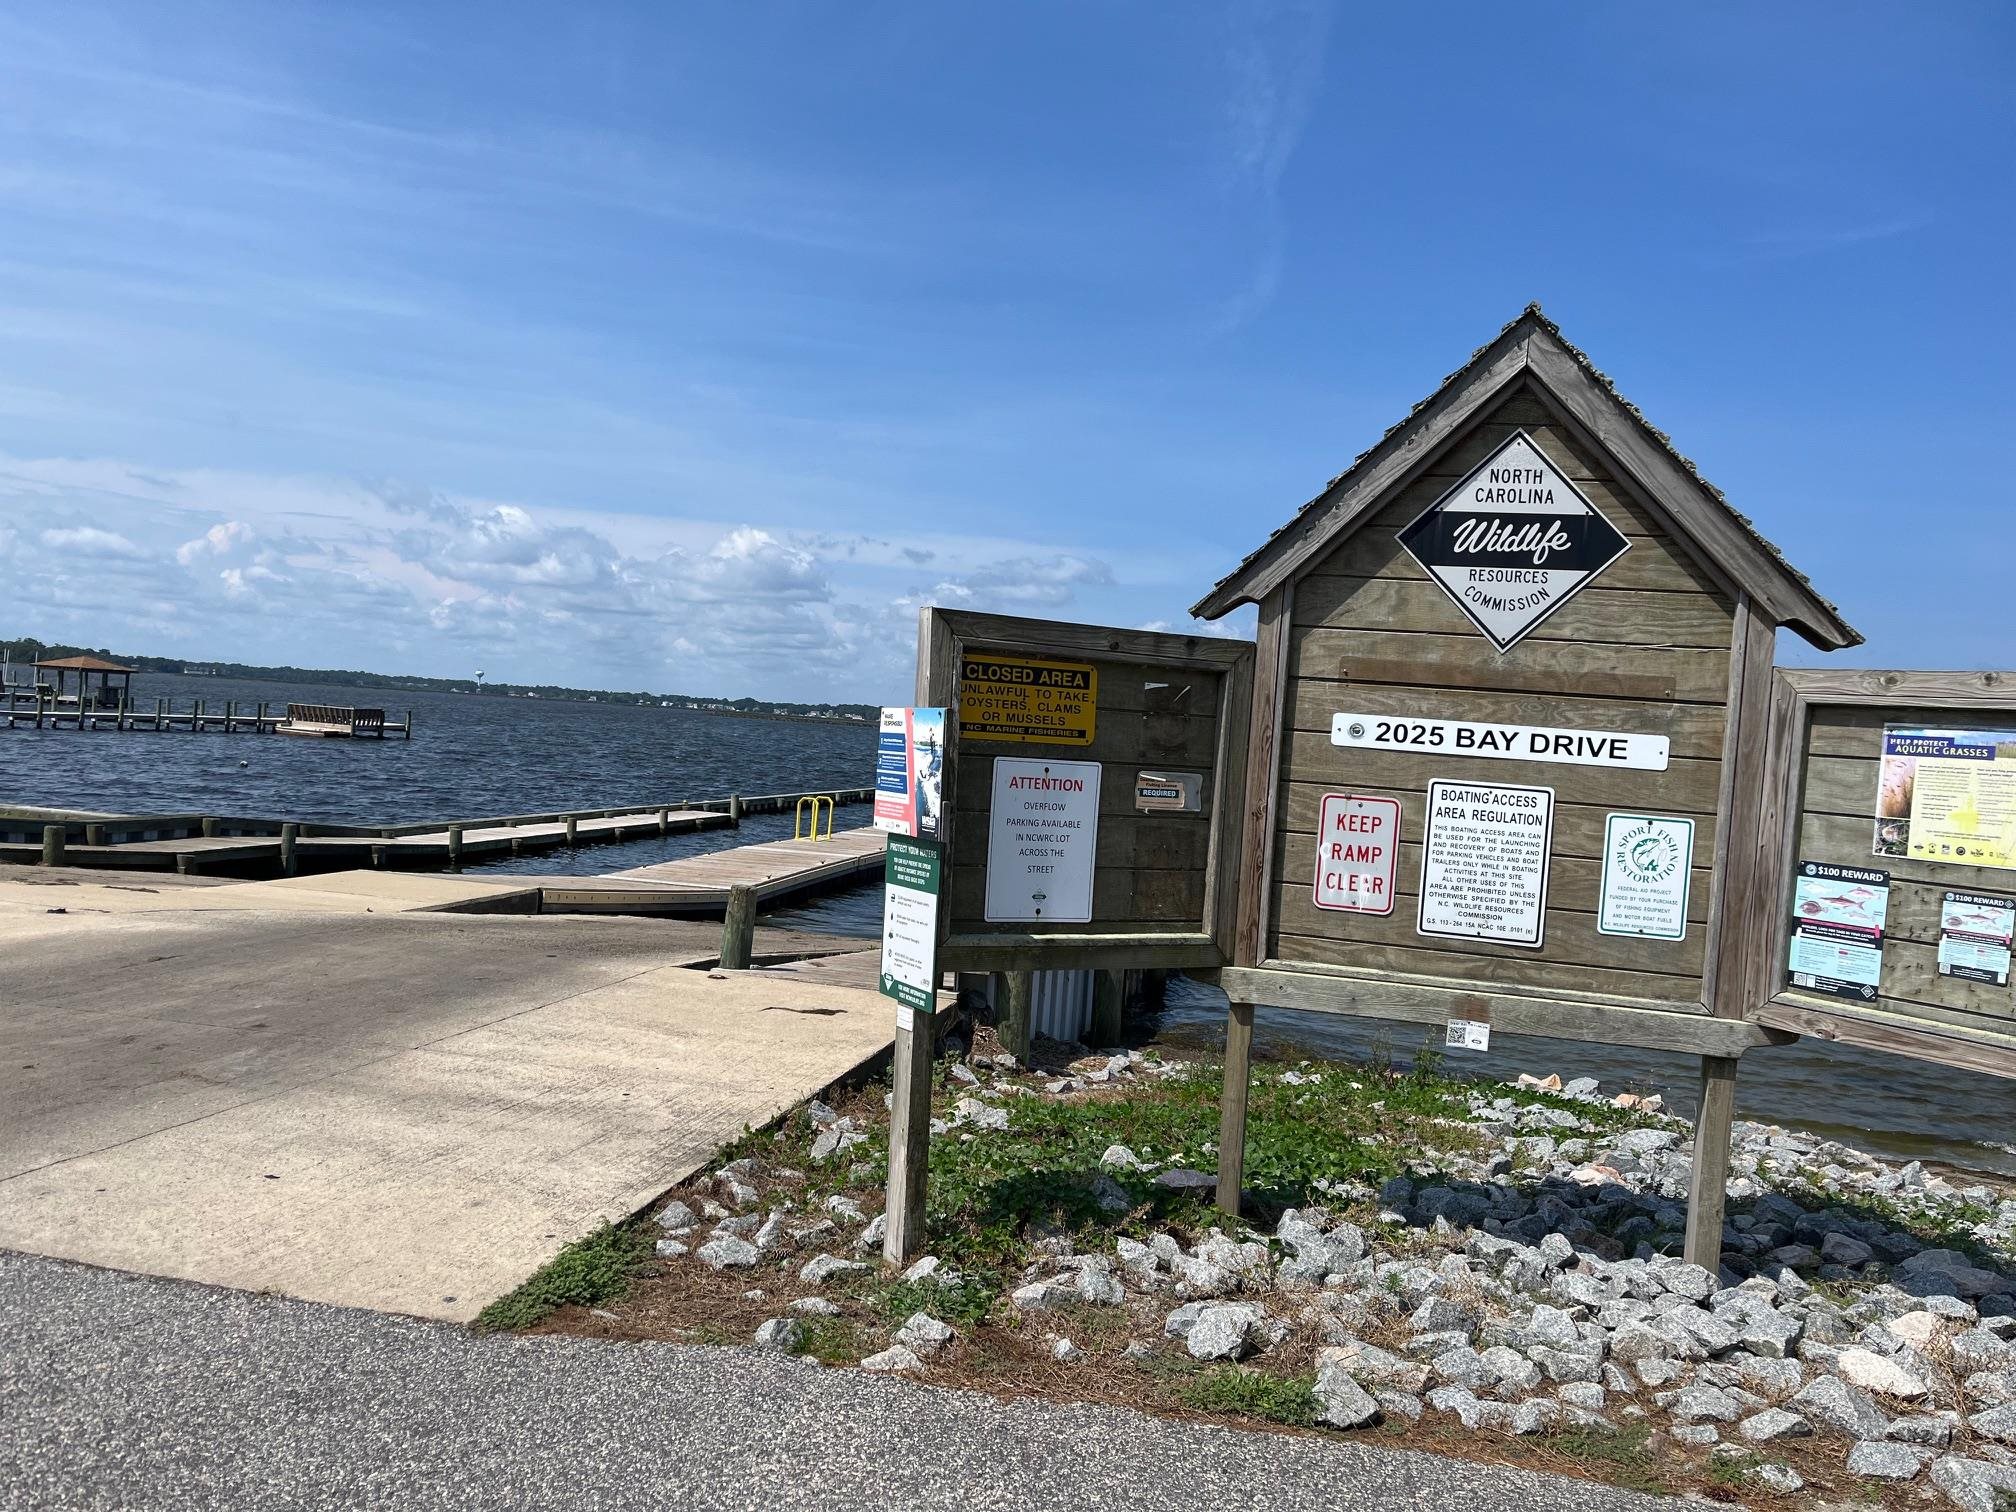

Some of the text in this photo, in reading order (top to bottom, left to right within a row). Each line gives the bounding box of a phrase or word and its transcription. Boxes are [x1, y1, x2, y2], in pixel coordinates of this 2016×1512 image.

[1490, 469, 1543, 484] NORTH
[1475, 488, 1554, 505] CAROLINA
[1453, 518, 1572, 565] Wildlife
[1469, 569, 1549, 584] RESOURCES
[1465, 586, 1550, 612] COMMISSION
[967, 665, 1084, 687] CLOSED AREA
[961, 684, 1089, 703] UNLAWFUL TO TAKE
[967, 697, 1081, 714] OYSTERS, CLAMS
[982, 712, 1066, 726] OR MUSSELS
[987, 725, 1025, 734] MARINE
[1028, 728, 1079, 737] FISHERIES
[1375, 722, 1629, 760] 2025 BAY DRIVE
[1895, 745, 1988, 757] AQUATIC GRASSES
[1009, 777, 1083, 792] ATTENTION
[1442, 790, 1537, 808] BOATING ACCESS
[1024, 802, 1066, 811] OVERFLOW
[1007, 818, 1081, 829] PARKING AVAILABLE
[1337, 814, 1382, 833] KEEP
[1436, 807, 1543, 826] AREA REGULATION
[1451, 826, 1478, 834] BOATING
[1026, 834, 1054, 843] NCWRC
[1056, 835, 1070, 843] LOT
[1501, 839, 1540, 848] LAUNCHING
[1619, 826, 1678, 852] SPORT FISH
[1019, 849, 1064, 857] ACROSS THE
[1332, 843, 1383, 863] RAMP
[1450, 843, 1485, 851] RECOVERY
[1447, 851, 1473, 859] PARKING
[1476, 854, 1504, 862] VEHICLES
[1027, 866, 1054, 874] STREET
[1432, 858, 1459, 866] TRAILERS
[1512, 866, 1538, 874] BOATING
[1444, 868, 1477, 876] ACTIVITIES
[1617, 852, 1678, 884] RESTORATION
[1818, 866, 1883, 882] $100 REWARD
[1429, 892, 1467, 901] OTHERWISE
[1471, 896, 1506, 904] SPECIFIED
[1467, 888, 1506, 896] PROHIBITED
[1454, 902, 1482, 910] WILDLIFE
[1485, 905, 1524, 914] RESOURCES
[1974, 898, 2004, 906] REWARD
[1458, 911, 1503, 921] COMMISSION
